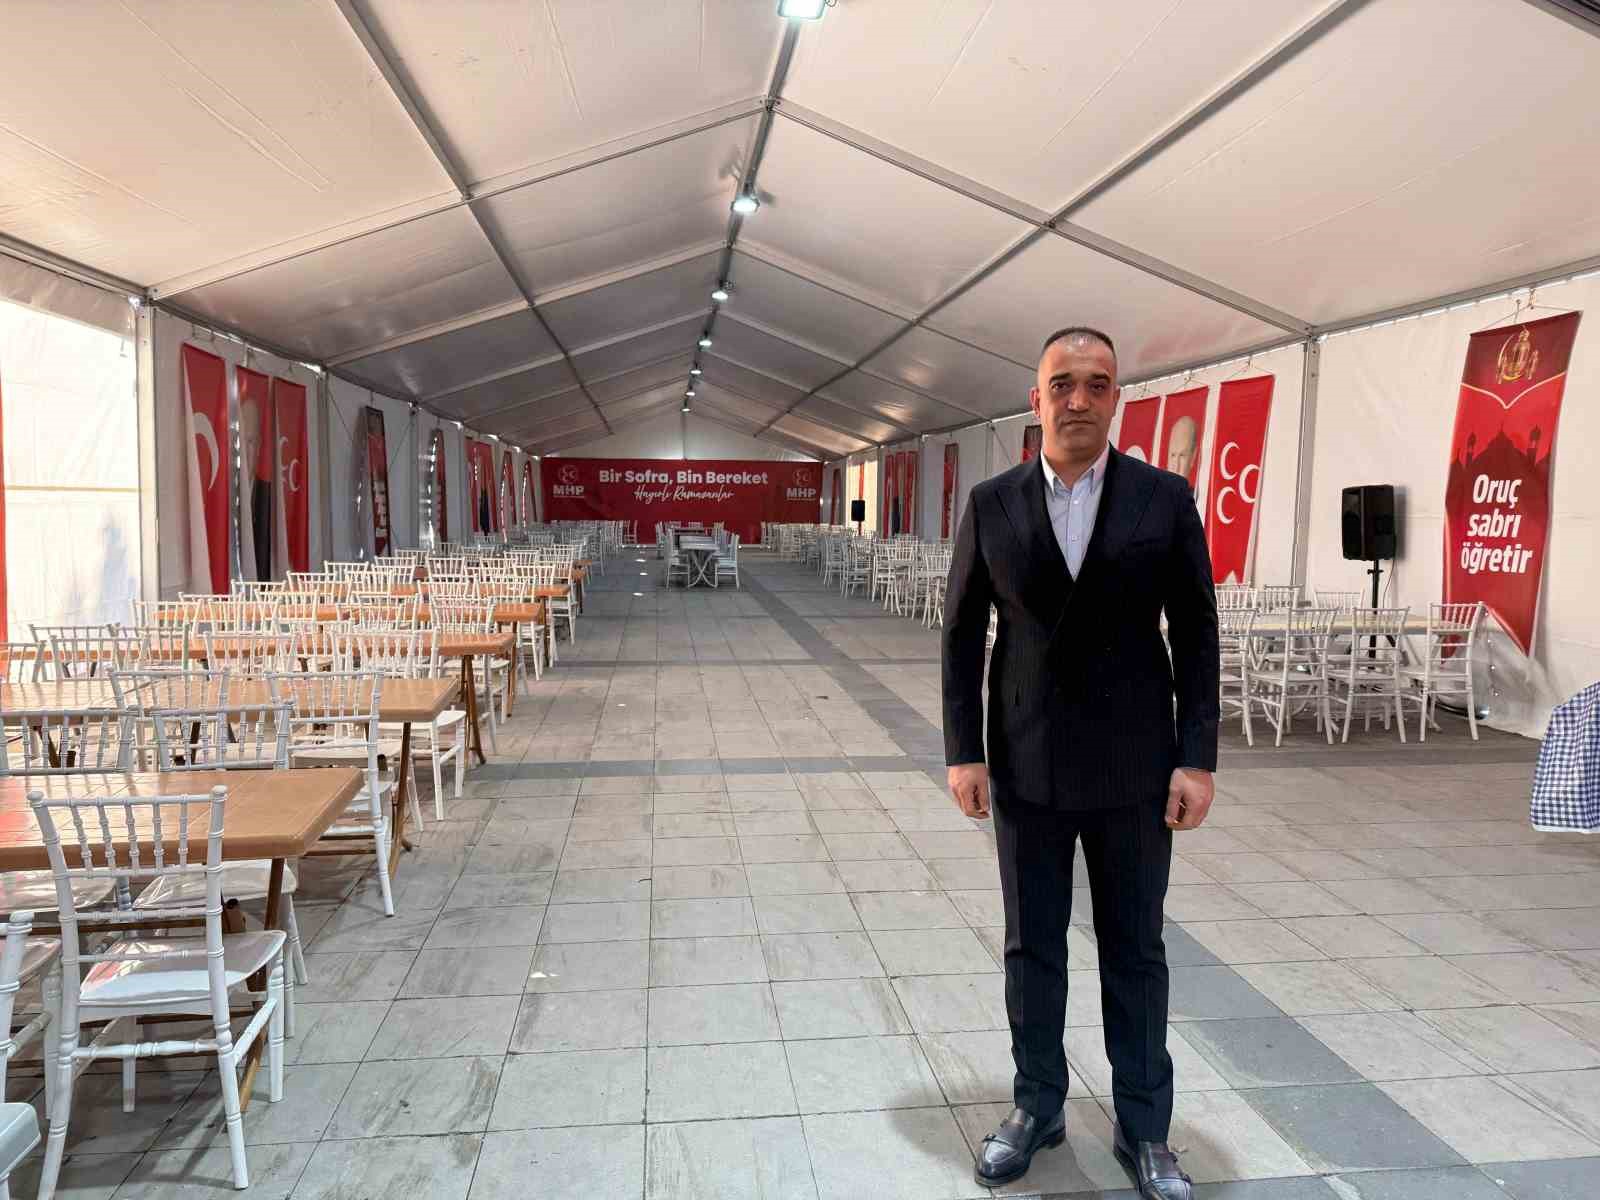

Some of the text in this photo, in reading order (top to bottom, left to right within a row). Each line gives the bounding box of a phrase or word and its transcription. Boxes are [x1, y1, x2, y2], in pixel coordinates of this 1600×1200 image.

[599, 469, 768, 485] Bir Sofra, Bin Bereket
[553, 484, 584, 496] MHP
[786, 487, 816, 498] MHP
[1472, 474, 1522, 509] Oruç
[1467, 508, 1522, 538] sabrı
[1461, 541, 1534, 574] öğretir
